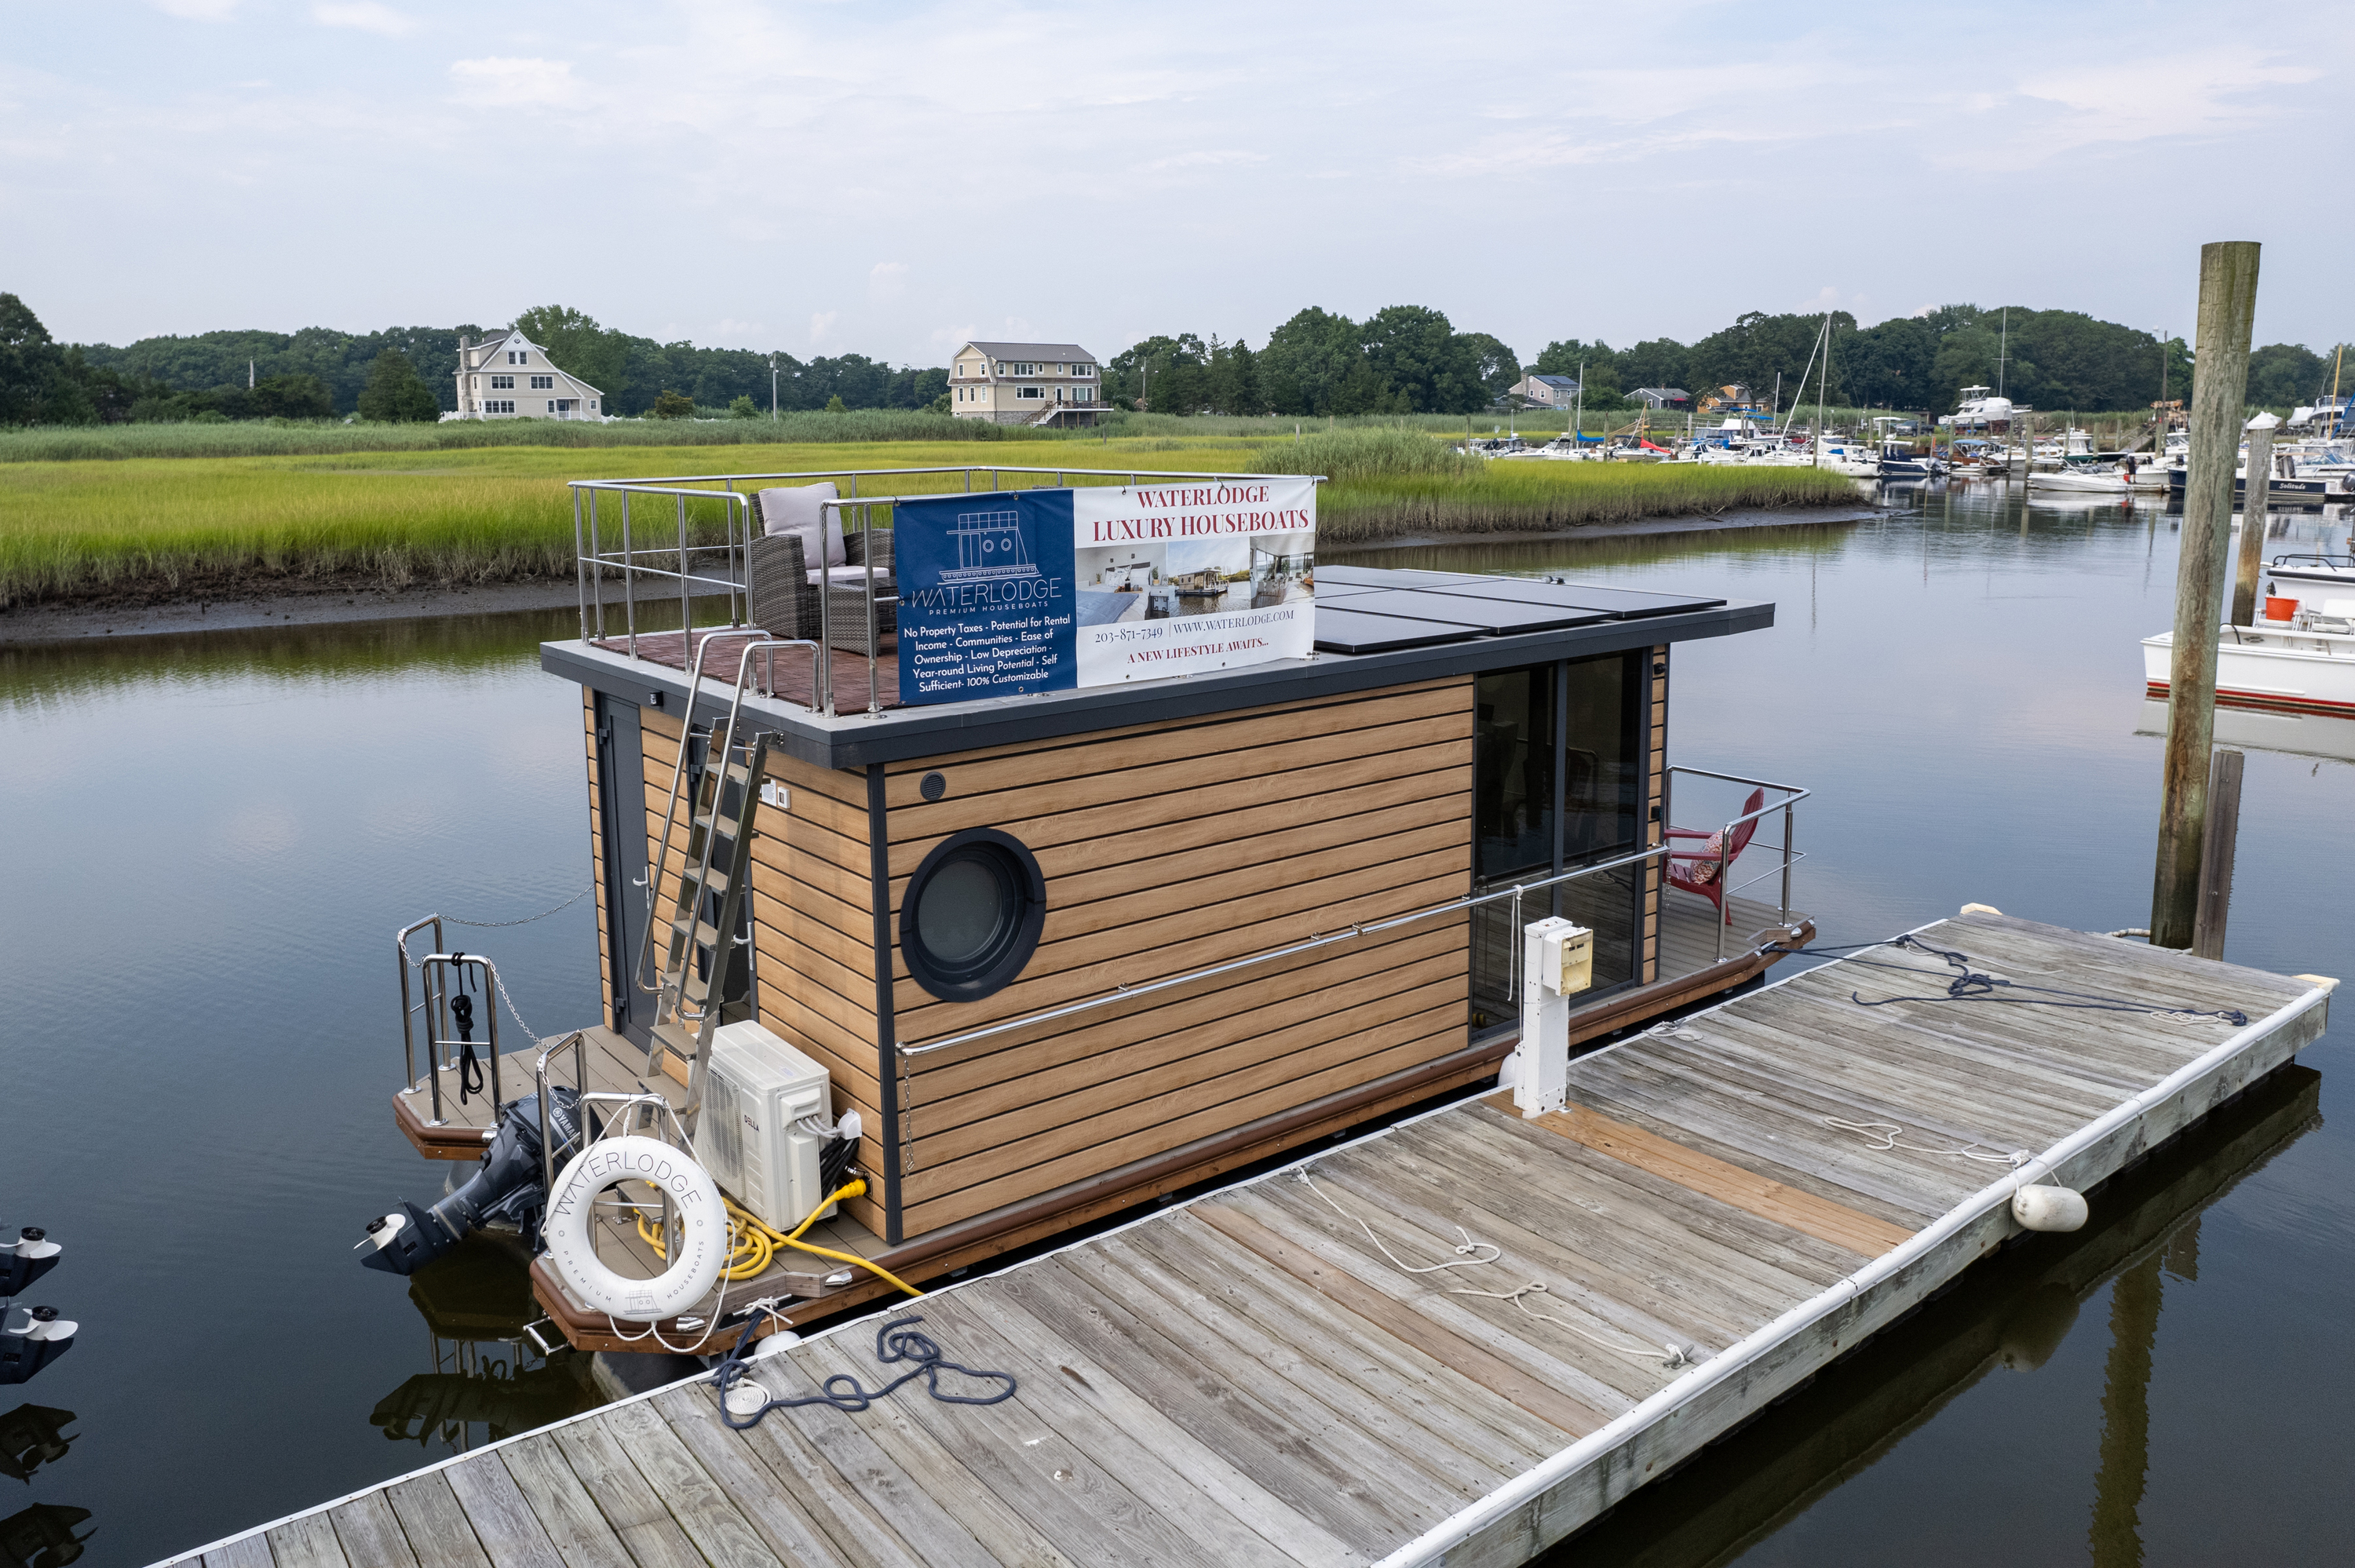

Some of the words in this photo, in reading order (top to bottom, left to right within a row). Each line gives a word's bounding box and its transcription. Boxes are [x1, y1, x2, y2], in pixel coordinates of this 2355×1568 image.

[1137, 486, 1269, 509] WATERLODGE
[1094, 516, 1176, 542] LUXURY
[1181, 509, 1309, 536] HOUSEBOATS
[911, 578, 1062, 608] WATERLODGE
[929, 607, 976, 616] PREMIUM
[982, 600, 1049, 612] HOUSEBOATS
[904, 627, 918, 638] No
[920, 625, 956, 638] Property
[958, 623, 983, 634] Taxes
[991, 618, 1028, 631] Potential
[1030, 616, 1042, 627] for
[1044, 614, 1071, 625] Rental
[1095, 627, 1163, 644] 203-871-7349
[1173, 609, 1294, 634] WWW.WATERLODGE.COM
[915, 640, 947, 651] Income
[955, 634, 1013, 648] Communities
[1021, 631, 1042, 642] Ease
[1044, 629, 1053, 640] of
[1126, 653, 1136, 664] A
[1137, 650, 1163, 662] NEW
[1166, 643, 1224, 660] LIFESTYLE
[1225, 637, 1269, 652] AWAITS...
[913, 664, 965, 679] Year-round
[966, 661, 995, 674] Living
[997, 656, 1035, 671] Potential
[1042, 654, 1058, 665] Self
[914, 651, 962, 665] Ownership
[970, 650, 989, 661] Low
[991, 644, 1047, 658] Depreciation
[918, 679, 965, 692] Sufficient-
[966, 676, 990, 687] 100%
[992, 669, 1049, 684] Customizable
[743, 1114, 760, 1133] DELLA
[554, 1150, 703, 1216] WATERLODGE
[563, 1250, 612, 1302] PREMIUM
[666, 1241, 704, 1300] HOUSEBOATS
